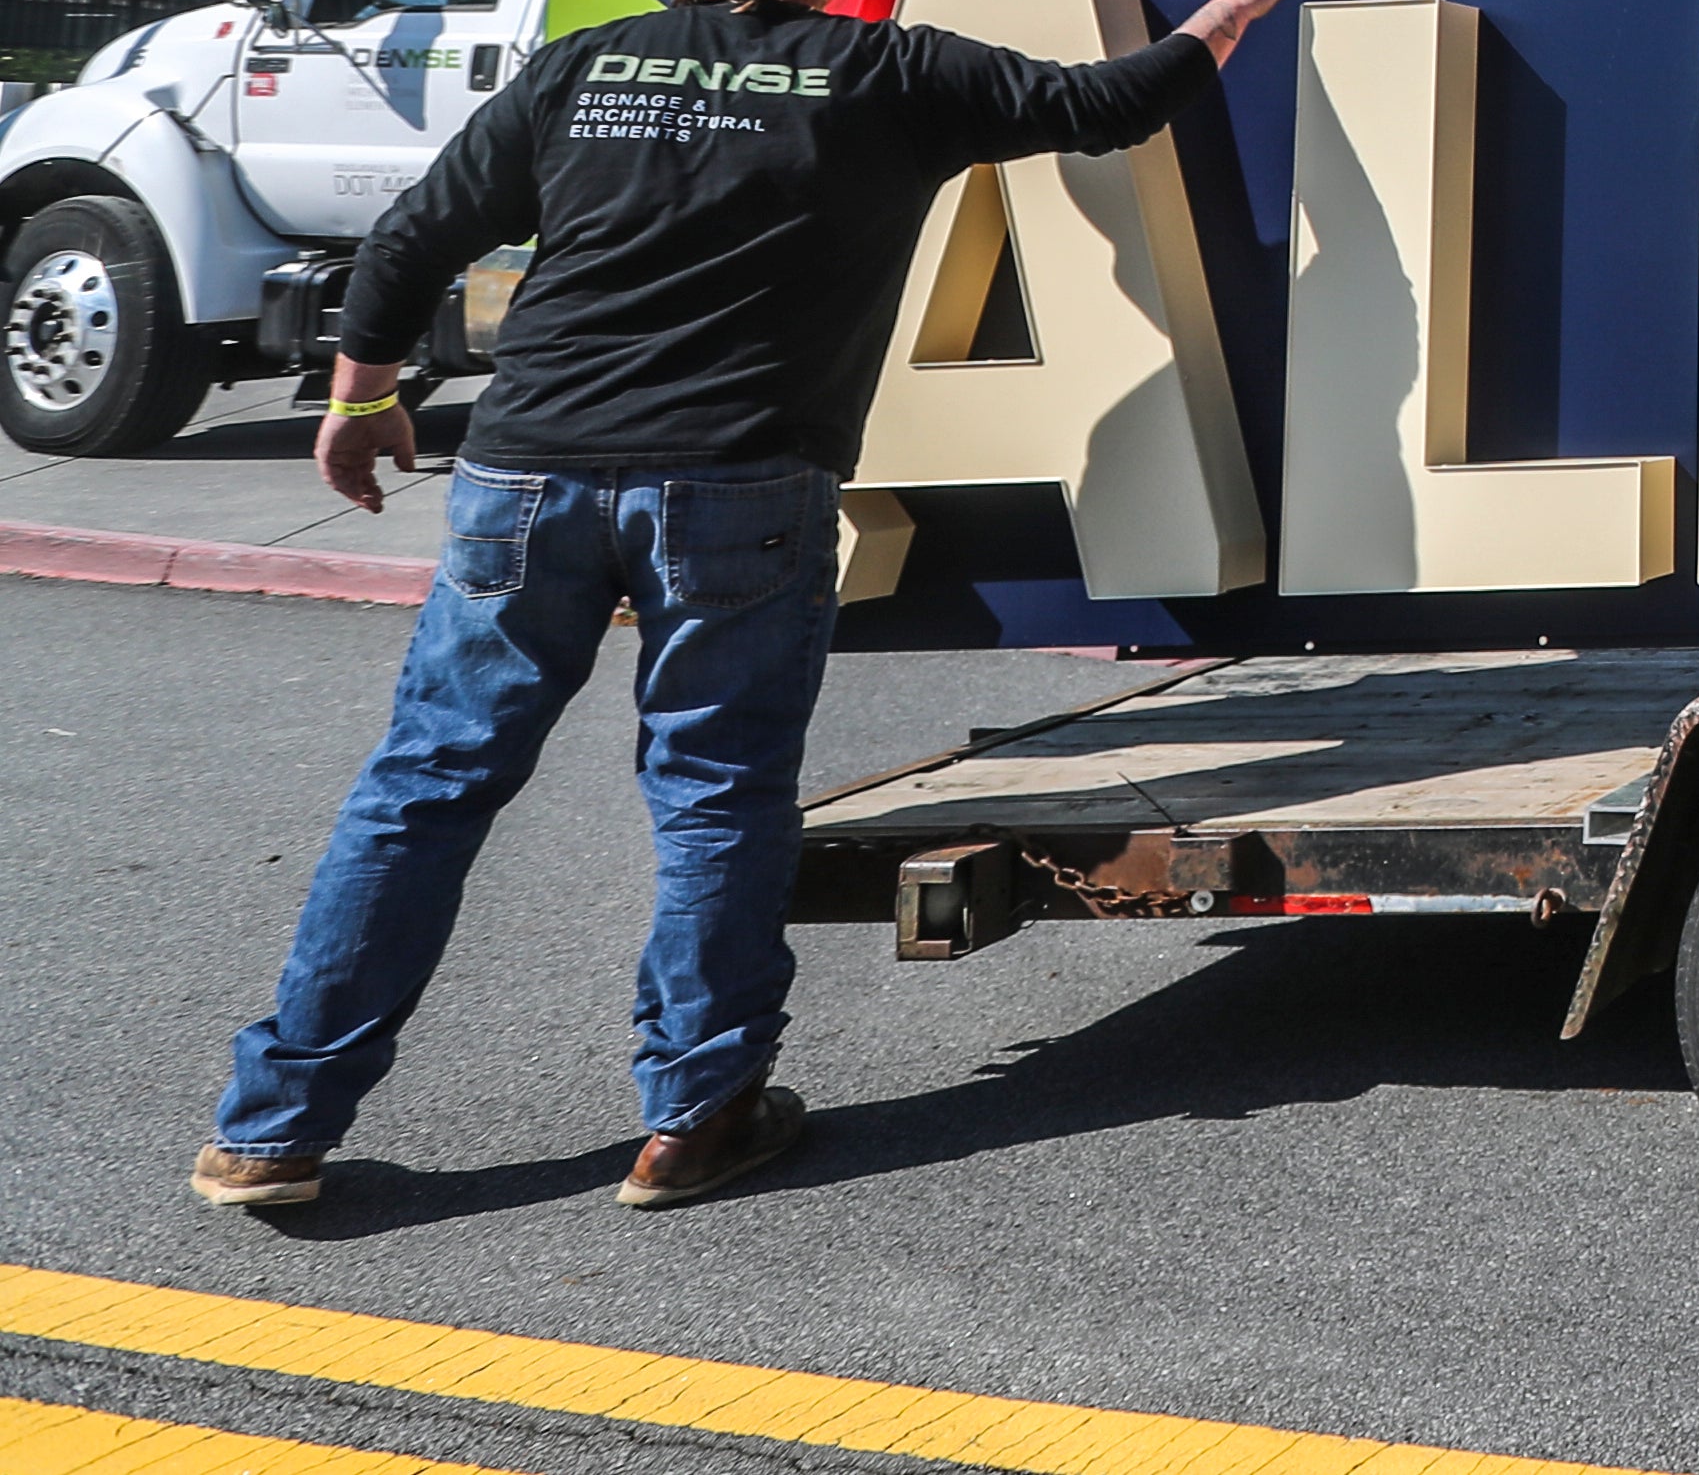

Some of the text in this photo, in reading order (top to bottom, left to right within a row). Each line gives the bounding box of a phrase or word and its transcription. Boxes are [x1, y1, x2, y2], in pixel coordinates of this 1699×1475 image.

[351, 48, 463, 69] DENYSE
[586, 54, 831, 97] DENYSE
[577, 92, 706, 112] SIGNAGE &
[573, 108, 766, 132] ARCHITECTURAL
[569, 125, 692, 143] ELEMENTS
[334, 175, 376, 196] DOT
